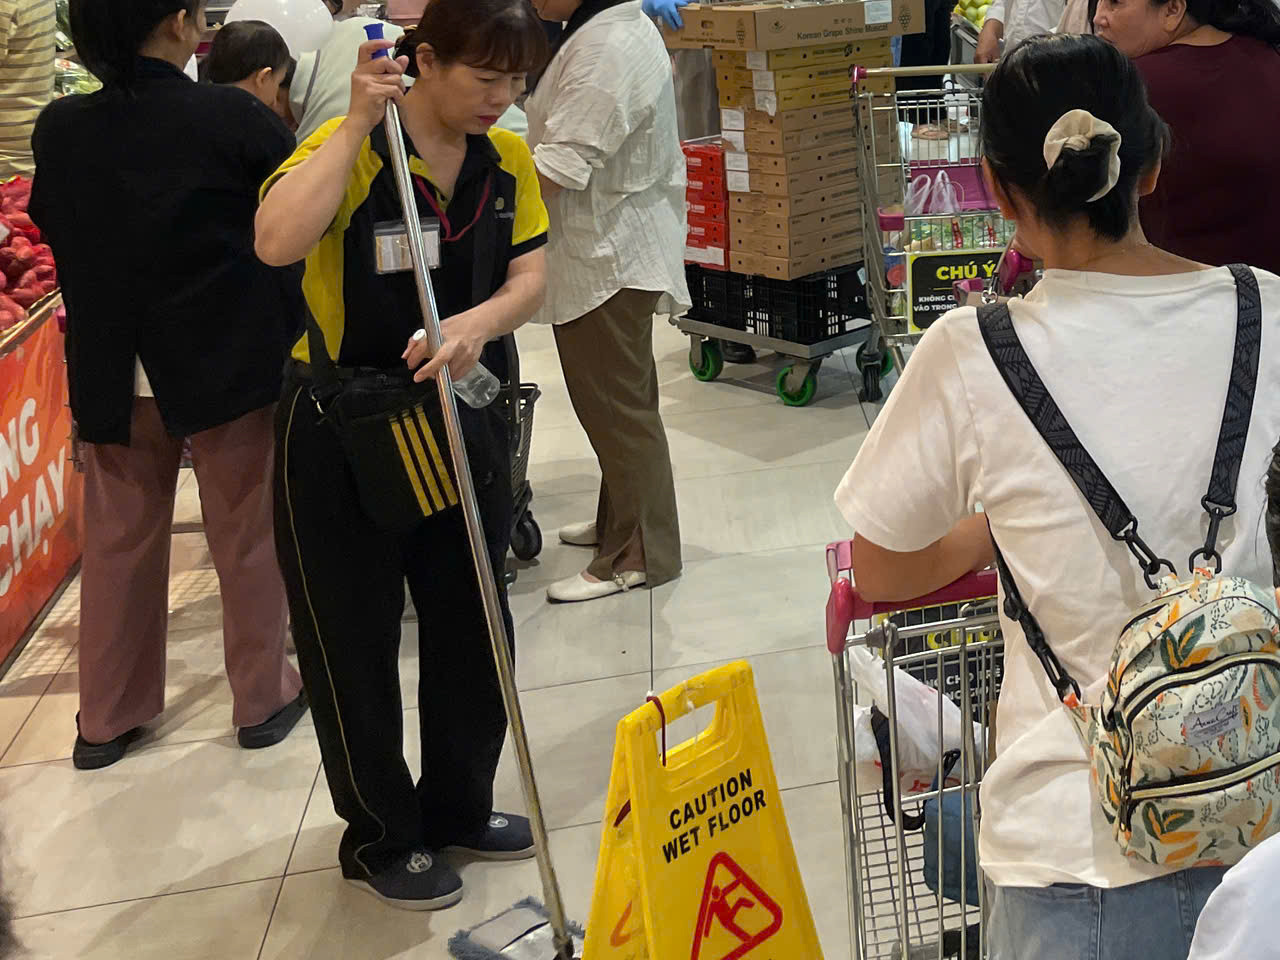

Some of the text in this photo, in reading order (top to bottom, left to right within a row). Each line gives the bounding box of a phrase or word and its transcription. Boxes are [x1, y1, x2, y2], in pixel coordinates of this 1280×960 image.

[936, 260, 996, 280] CHÚ Ý
[913, 303, 930, 312] VÀO
[918, 295, 946, 303] KHÔNG
[669, 768, 753, 830] CAUTION
[662, 788, 767, 864] WET FLOOR
